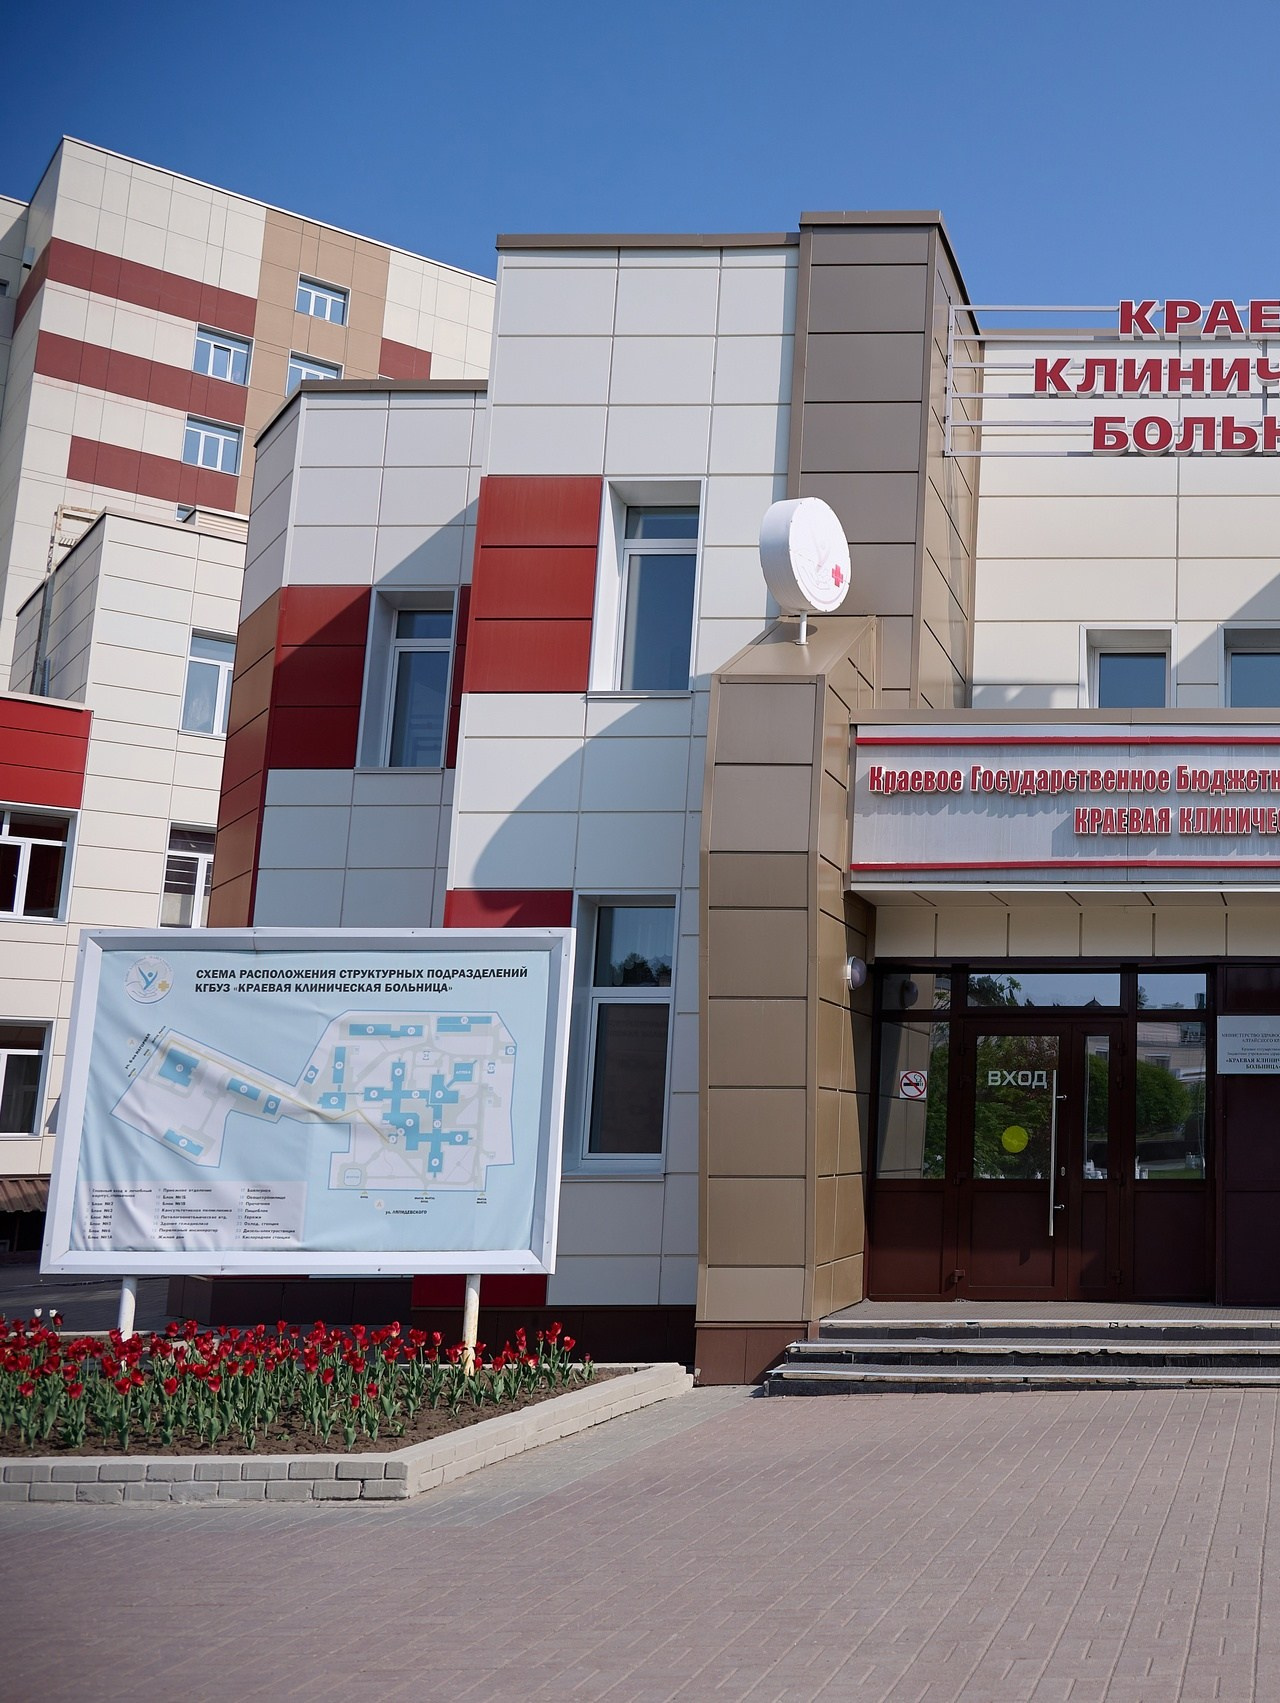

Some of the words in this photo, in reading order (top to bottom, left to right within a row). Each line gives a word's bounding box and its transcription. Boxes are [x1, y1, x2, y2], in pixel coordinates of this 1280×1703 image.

[868, 765, 962, 795] Краевое
[970, 764, 1170, 795] Государственное
[1073, 806, 1173, 836] КРАЕВАЯ
[195, 969, 237, 979] СХЕМА
[239, 969, 337, 979] РАСПОЛОЖЕНИЯ
[338, 968, 424, 979] СТРУКТУРНЫХ
[426, 966, 528, 979] ПОДРАЗДЕЛЕНИЙ
[195, 983, 231, 993] КГБУЗ
[233, 983, 292, 993] «КРАЕВАЯ
[294, 983, 382, 993] КЛИНИЧЕСКАЯ
[384, 982, 453, 993] БОЛЬНИЦА»
[987, 1070, 1048, 1089] ВХОД
